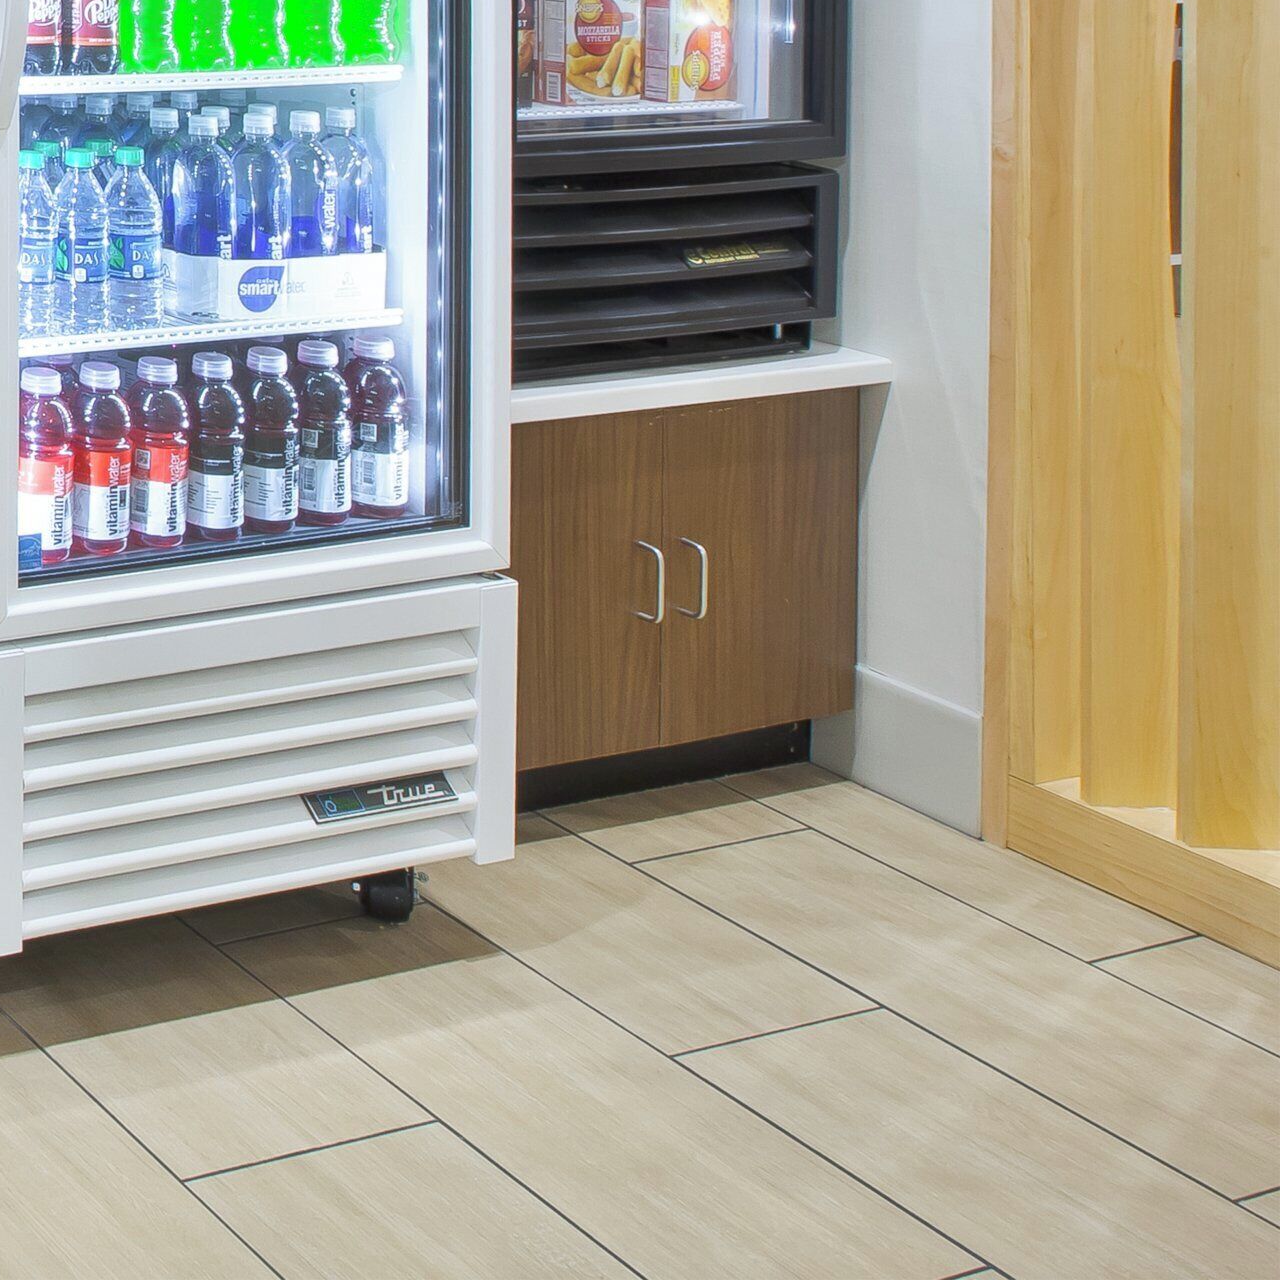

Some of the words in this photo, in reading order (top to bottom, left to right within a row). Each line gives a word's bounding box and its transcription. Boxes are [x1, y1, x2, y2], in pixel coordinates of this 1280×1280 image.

[578, 26, 620, 36] MOZZARELLA
[710, 31, 722, 82] PEPPER
[53, 464, 65, 546] vitaminwater
[108, 455, 120, 536] vitaminwater
[167, 452, 180, 533] vitaminwater
[231, 444, 243, 524] vitaminwater
[284, 437, 297, 517] vitaminwater
[336, 427, 351, 509] vitaminwater
